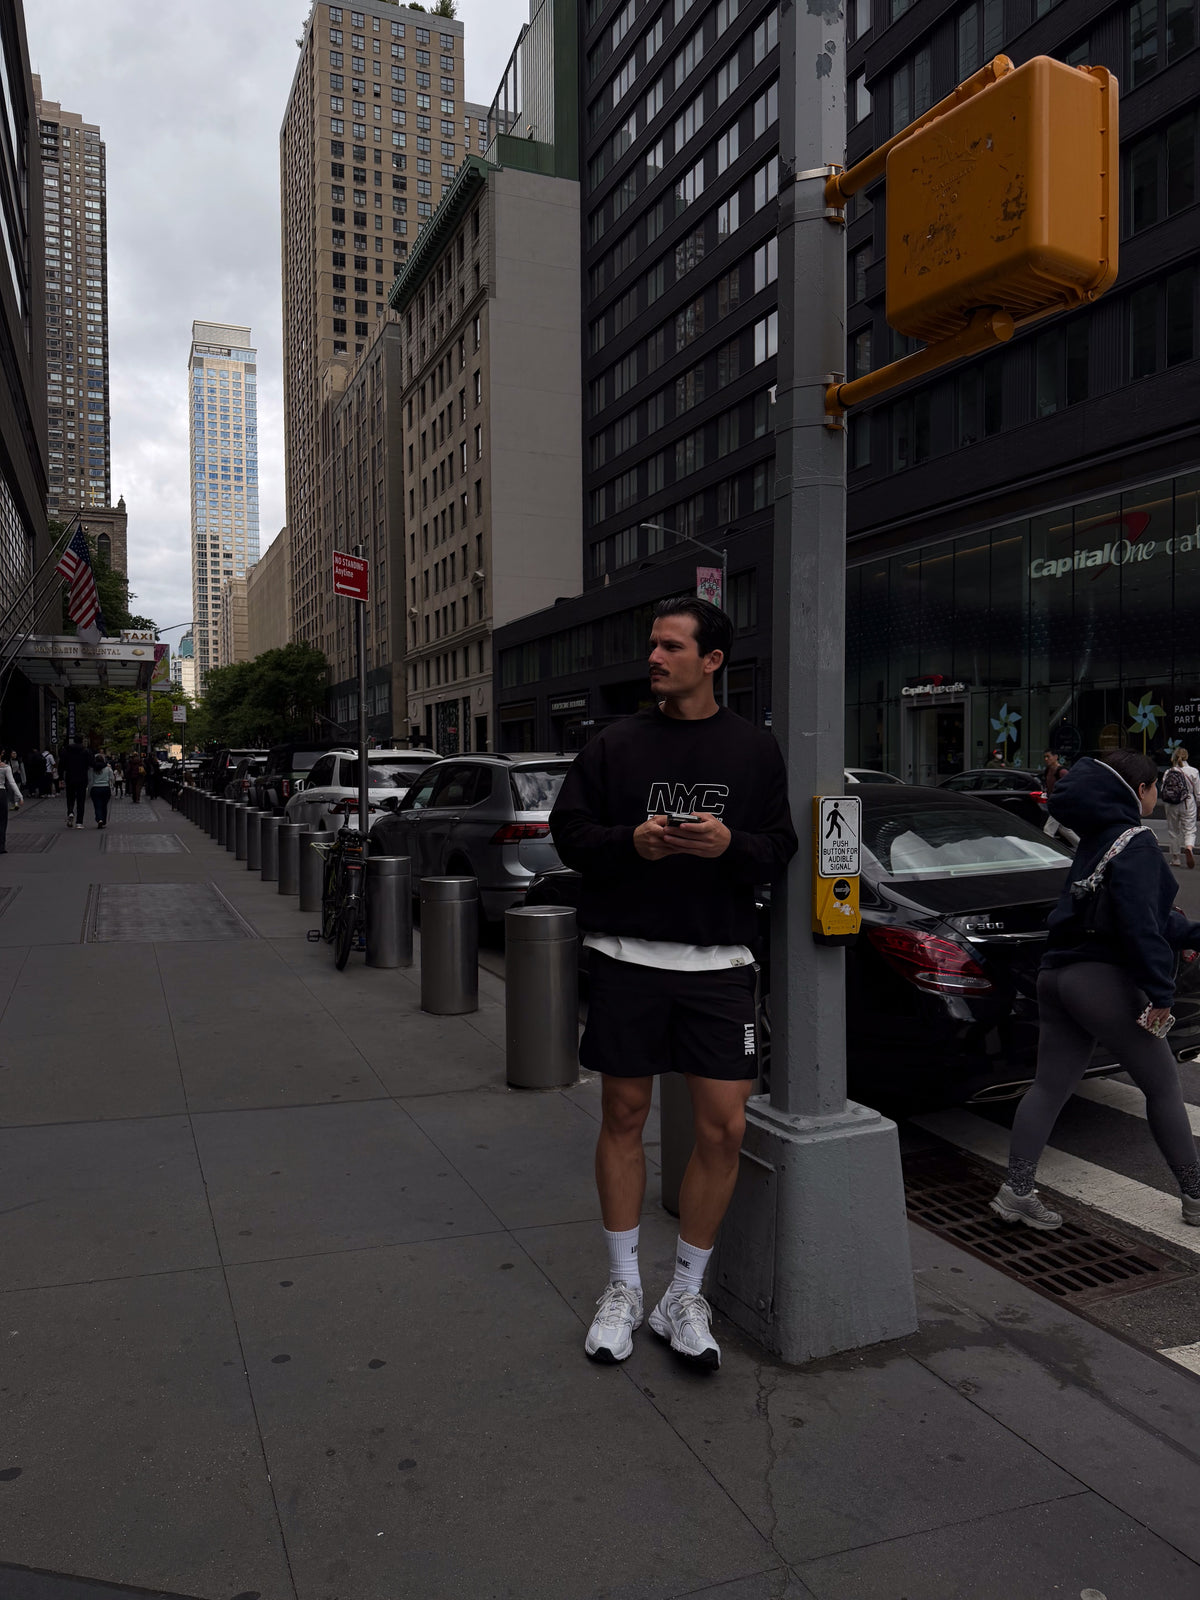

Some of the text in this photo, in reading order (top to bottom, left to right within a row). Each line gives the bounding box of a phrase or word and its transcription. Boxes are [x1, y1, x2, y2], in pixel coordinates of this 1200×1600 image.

[335, 556, 364, 572] NO STANDING
[335, 566, 354, 578] Anytime
[124, 632, 153, 641] TAXI
[1174, 704, 1195, 713] PART
[1174, 715, 1196, 724] PART
[647, 782, 729, 816] NYC
[833, 840, 849, 848] PUSH
[823, 847, 858, 856] BUTTON FOR
[828, 855, 853, 863] AUDIBLE
[830, 863, 851, 871] SIGNAL
[744, 1023, 755, 1056] LUME
